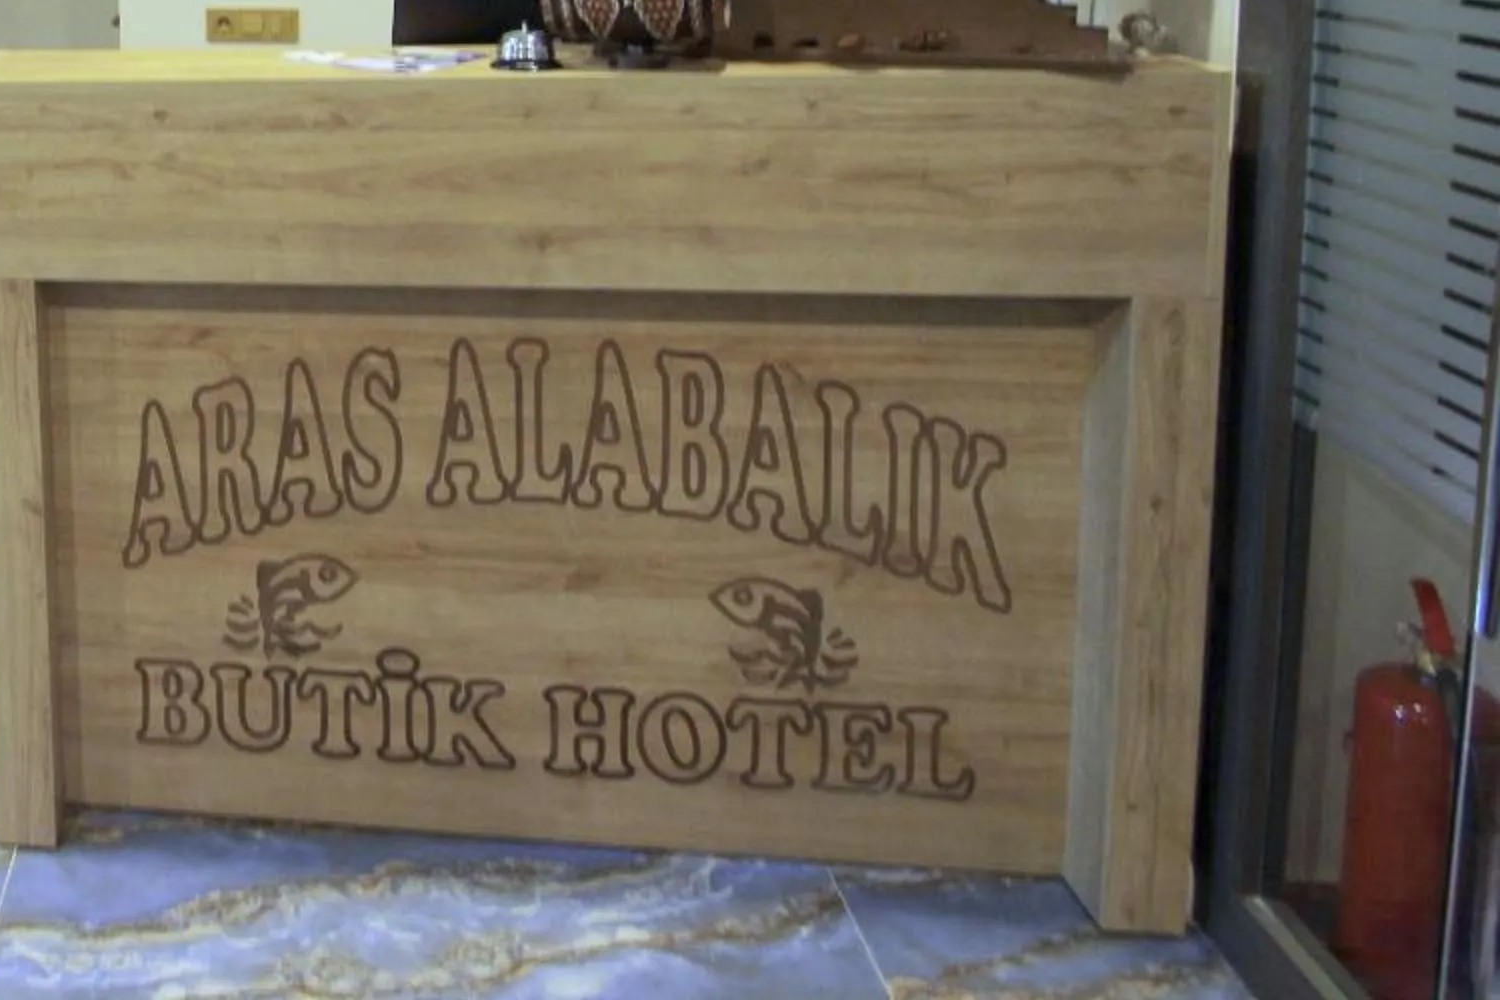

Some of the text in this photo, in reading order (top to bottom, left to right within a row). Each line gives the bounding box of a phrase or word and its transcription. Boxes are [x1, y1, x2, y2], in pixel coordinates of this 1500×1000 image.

[122, 337, 1012, 614] ARAS ALABALIK
[135, 646, 977, 801] BUTİK HOTEL
